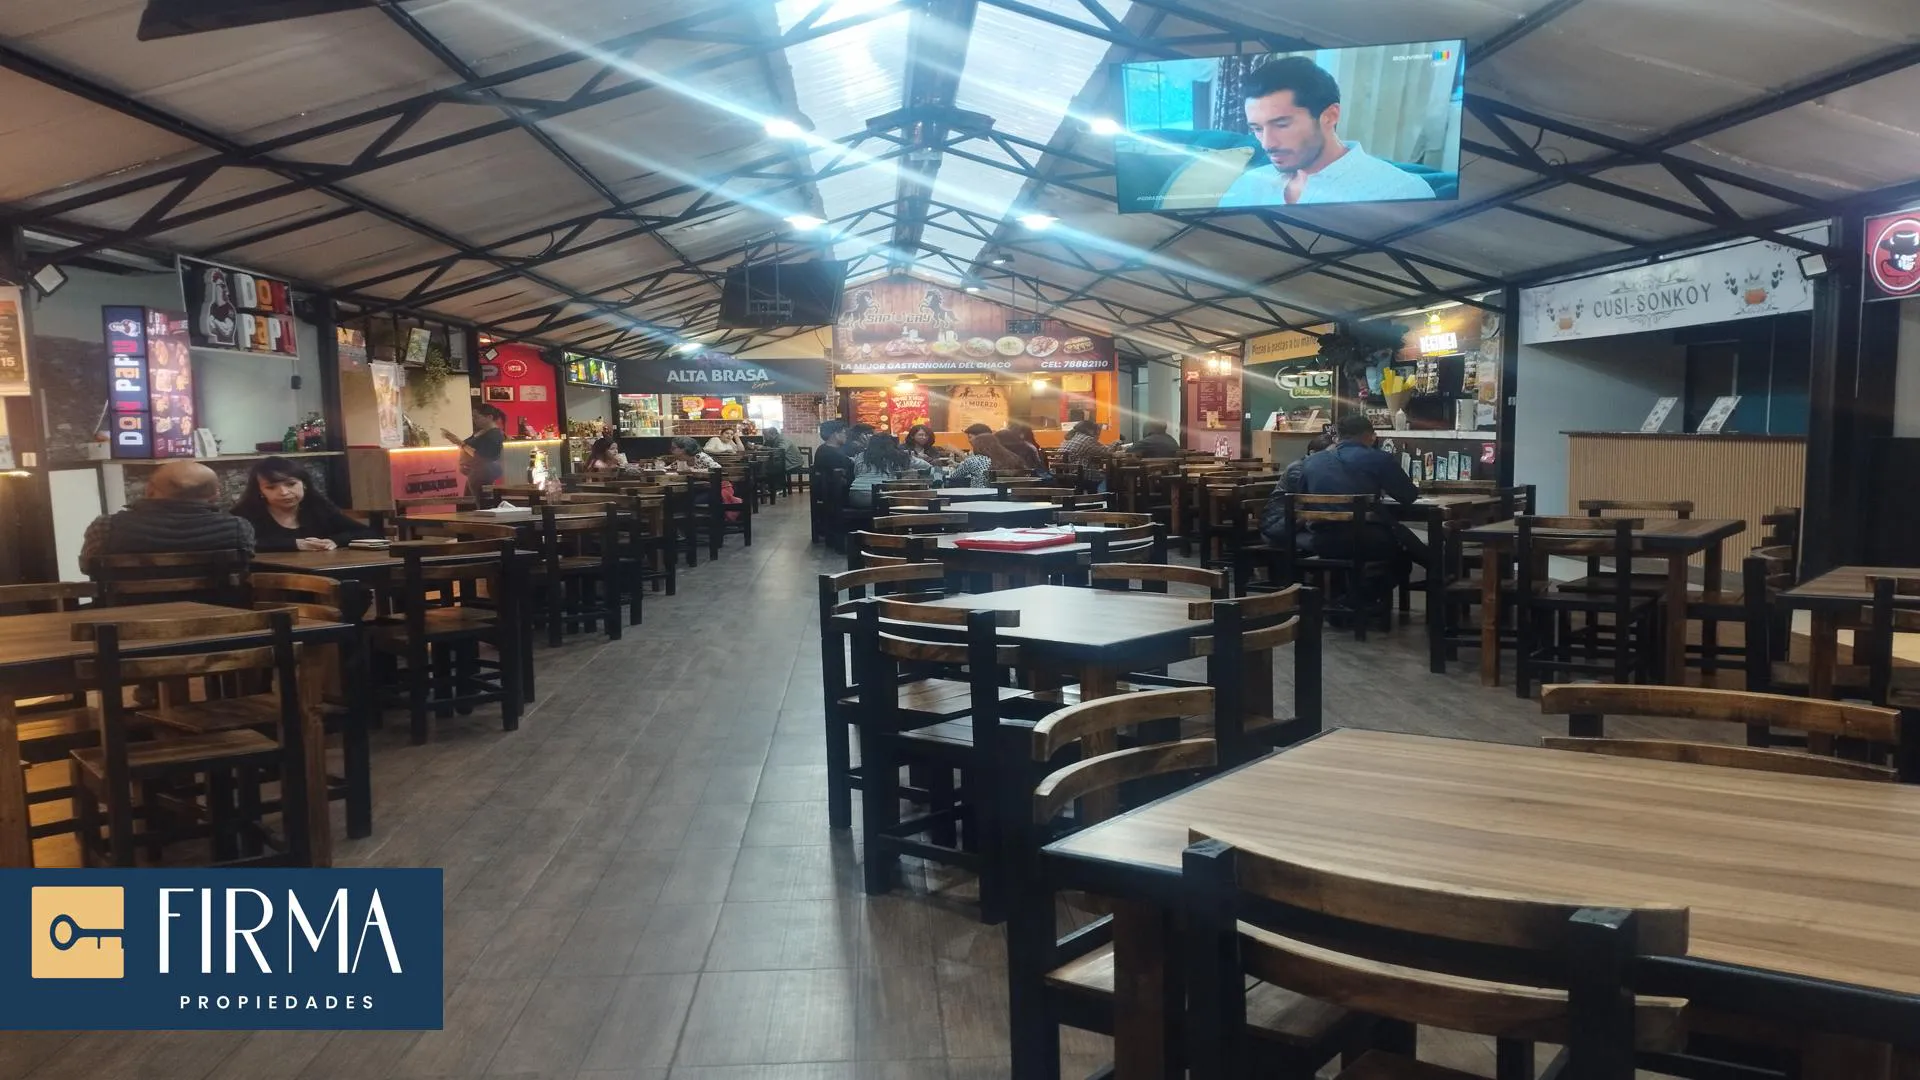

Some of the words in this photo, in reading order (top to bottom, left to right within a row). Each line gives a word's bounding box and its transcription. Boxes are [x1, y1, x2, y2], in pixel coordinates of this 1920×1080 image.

[1593, 283, 1711, 319] CUSI-SONKOY
[958, 361, 975, 369] DEL
[976, 361, 1012, 369] CHACO
[667, 369, 709, 383] ALTA
[711, 368, 769, 382] BRASA
